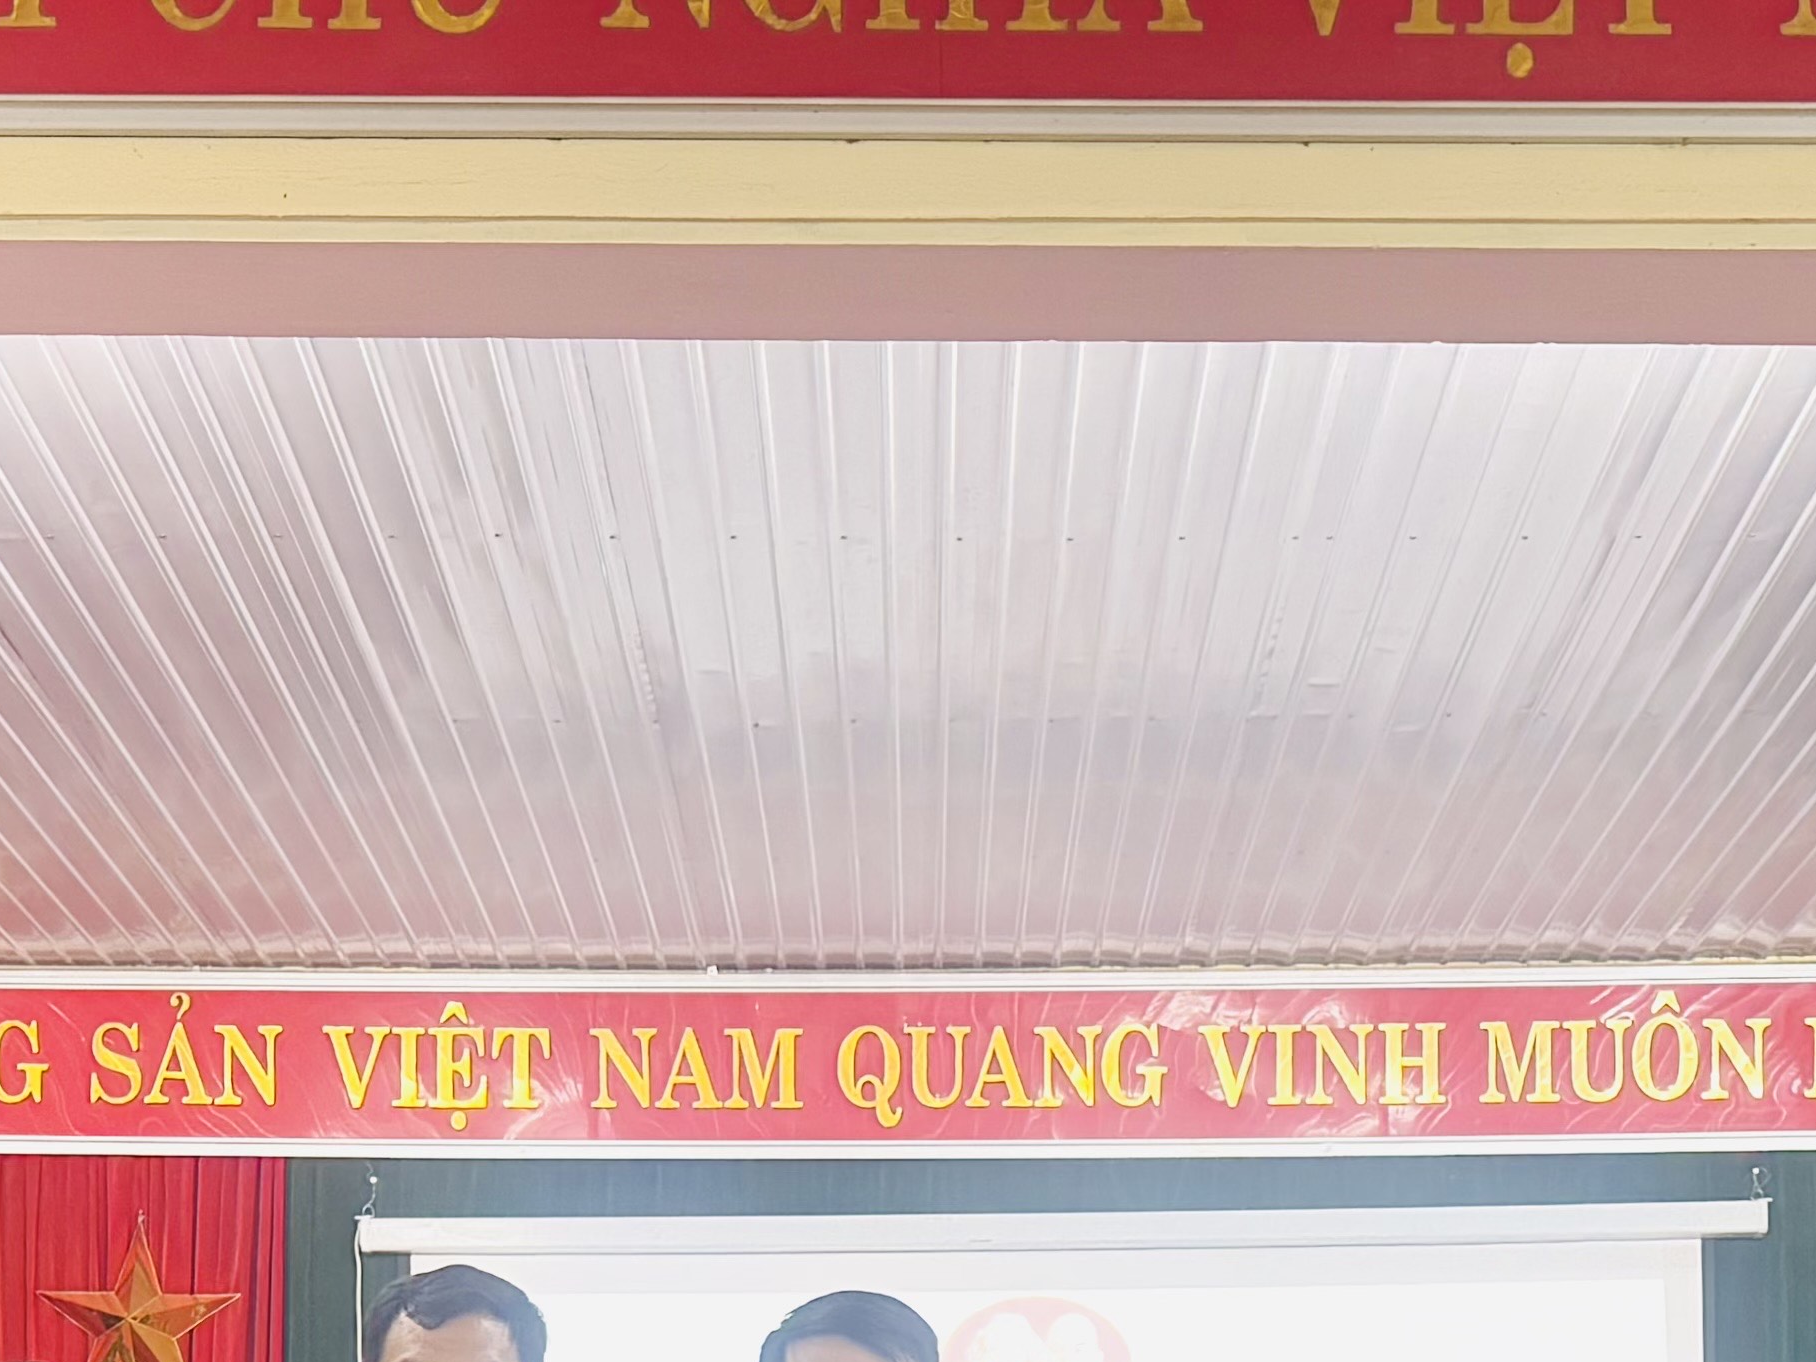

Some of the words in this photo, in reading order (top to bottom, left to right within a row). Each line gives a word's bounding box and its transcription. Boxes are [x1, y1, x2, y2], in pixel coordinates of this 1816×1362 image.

[90, 994, 284, 1107] SẢN
[324, 1001, 552, 1132] VIỆT
[591, 1028, 804, 1111] NAM
[837, 1025, 1167, 1129] QUANG
[1200, 1023, 1447, 1108] VINH
[1479, 990, 1769, 1105] MUÔN
